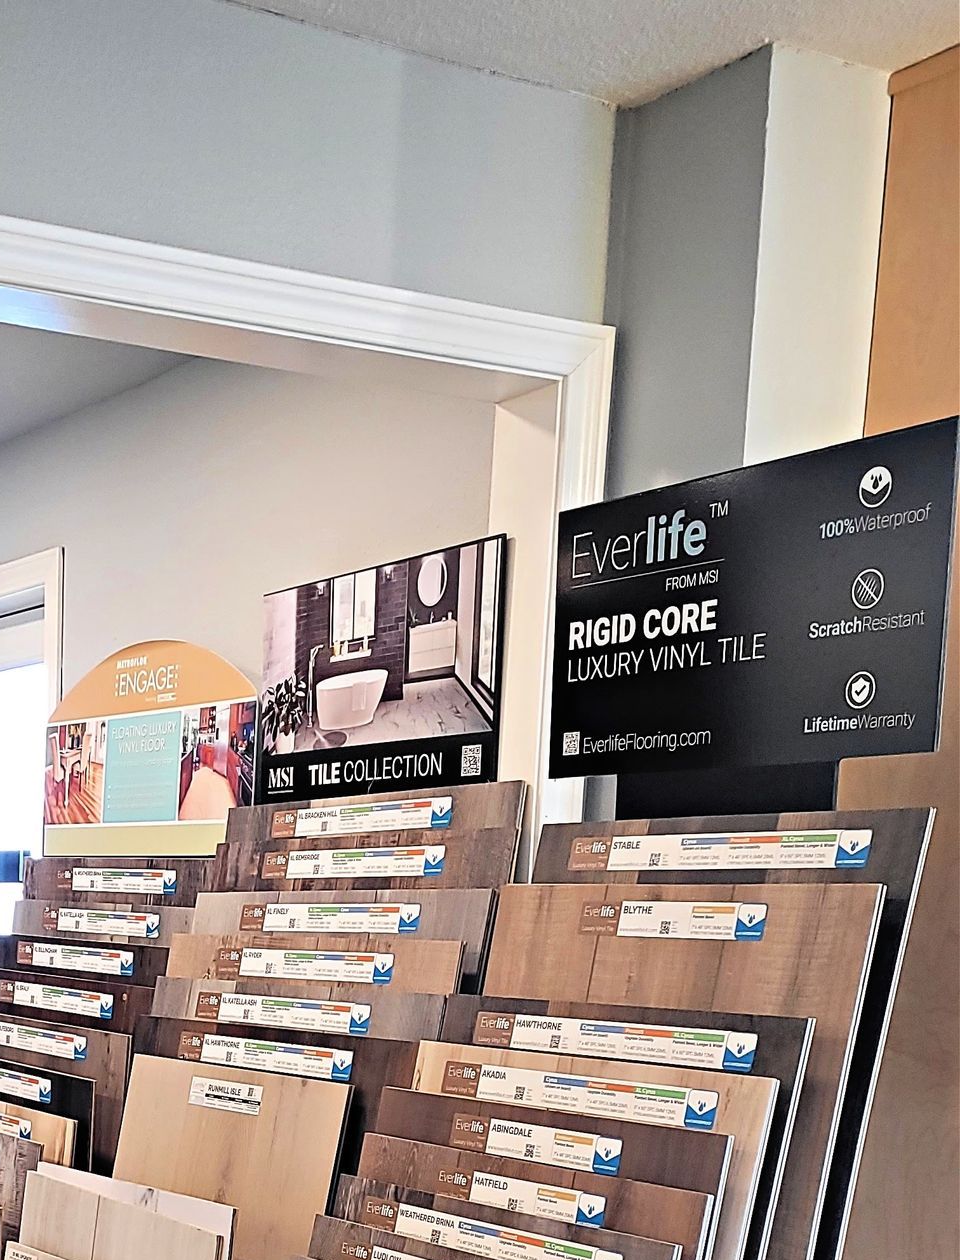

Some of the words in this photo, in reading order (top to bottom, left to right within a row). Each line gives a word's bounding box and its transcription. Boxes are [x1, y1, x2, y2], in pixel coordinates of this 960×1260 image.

[571, 509, 708, 580] Everlife
[709, 500, 730, 518] TM
[665, 573, 696, 592] FROM
[698, 569, 720, 587] MSI
[568, 609, 636, 651] RIGID
[643, 599, 718, 640] CORE
[567, 650, 644, 683] LUXURY
[649, 641, 711, 671] VINYL
[718, 633, 767, 664] TILE
[119, 665, 174, 696] ENGAGE
[112, 724, 148, 740] FLOATING
[149, 721, 177, 737] LUXURY
[118, 739, 139, 754] VINYL
[141, 738, 166, 753] FLOOR
[583, 728, 711, 754] EverlifeFlooring.com
[268, 766, 294, 788] MSI
[309, 762, 340, 786] TILE
[343, 752, 442, 784] COLLECTION
[304, 811, 326, 819] BRACKEN
[613, 841, 641, 850] STABLE
[623, 906, 653, 915] BLYTHE
[229, 998, 248, 1006] KATELLA
[516, 1020, 562, 1031] HAWTHORNE
[211, 1039, 240, 1049] HAWTHORNE
[482, 1069, 506, 1080] AKADIA
[208, 1084, 230, 1095] RUNMILL
[230, 1088, 242, 1096] ISLE
[455, 1119, 484, 1133] Everlife
[492, 1124, 532, 1138] ABINGDALE
[439, 1170, 467, 1186] Everlife
[475, 1176, 508, 1191] HATFIELD
[366, 1202, 394, 1217] Everlife
[400, 1209, 435, 1224] WEATHERED
[436, 1217, 455, 1228] BRINA
[341, 1242, 368, 1259] Everlife
